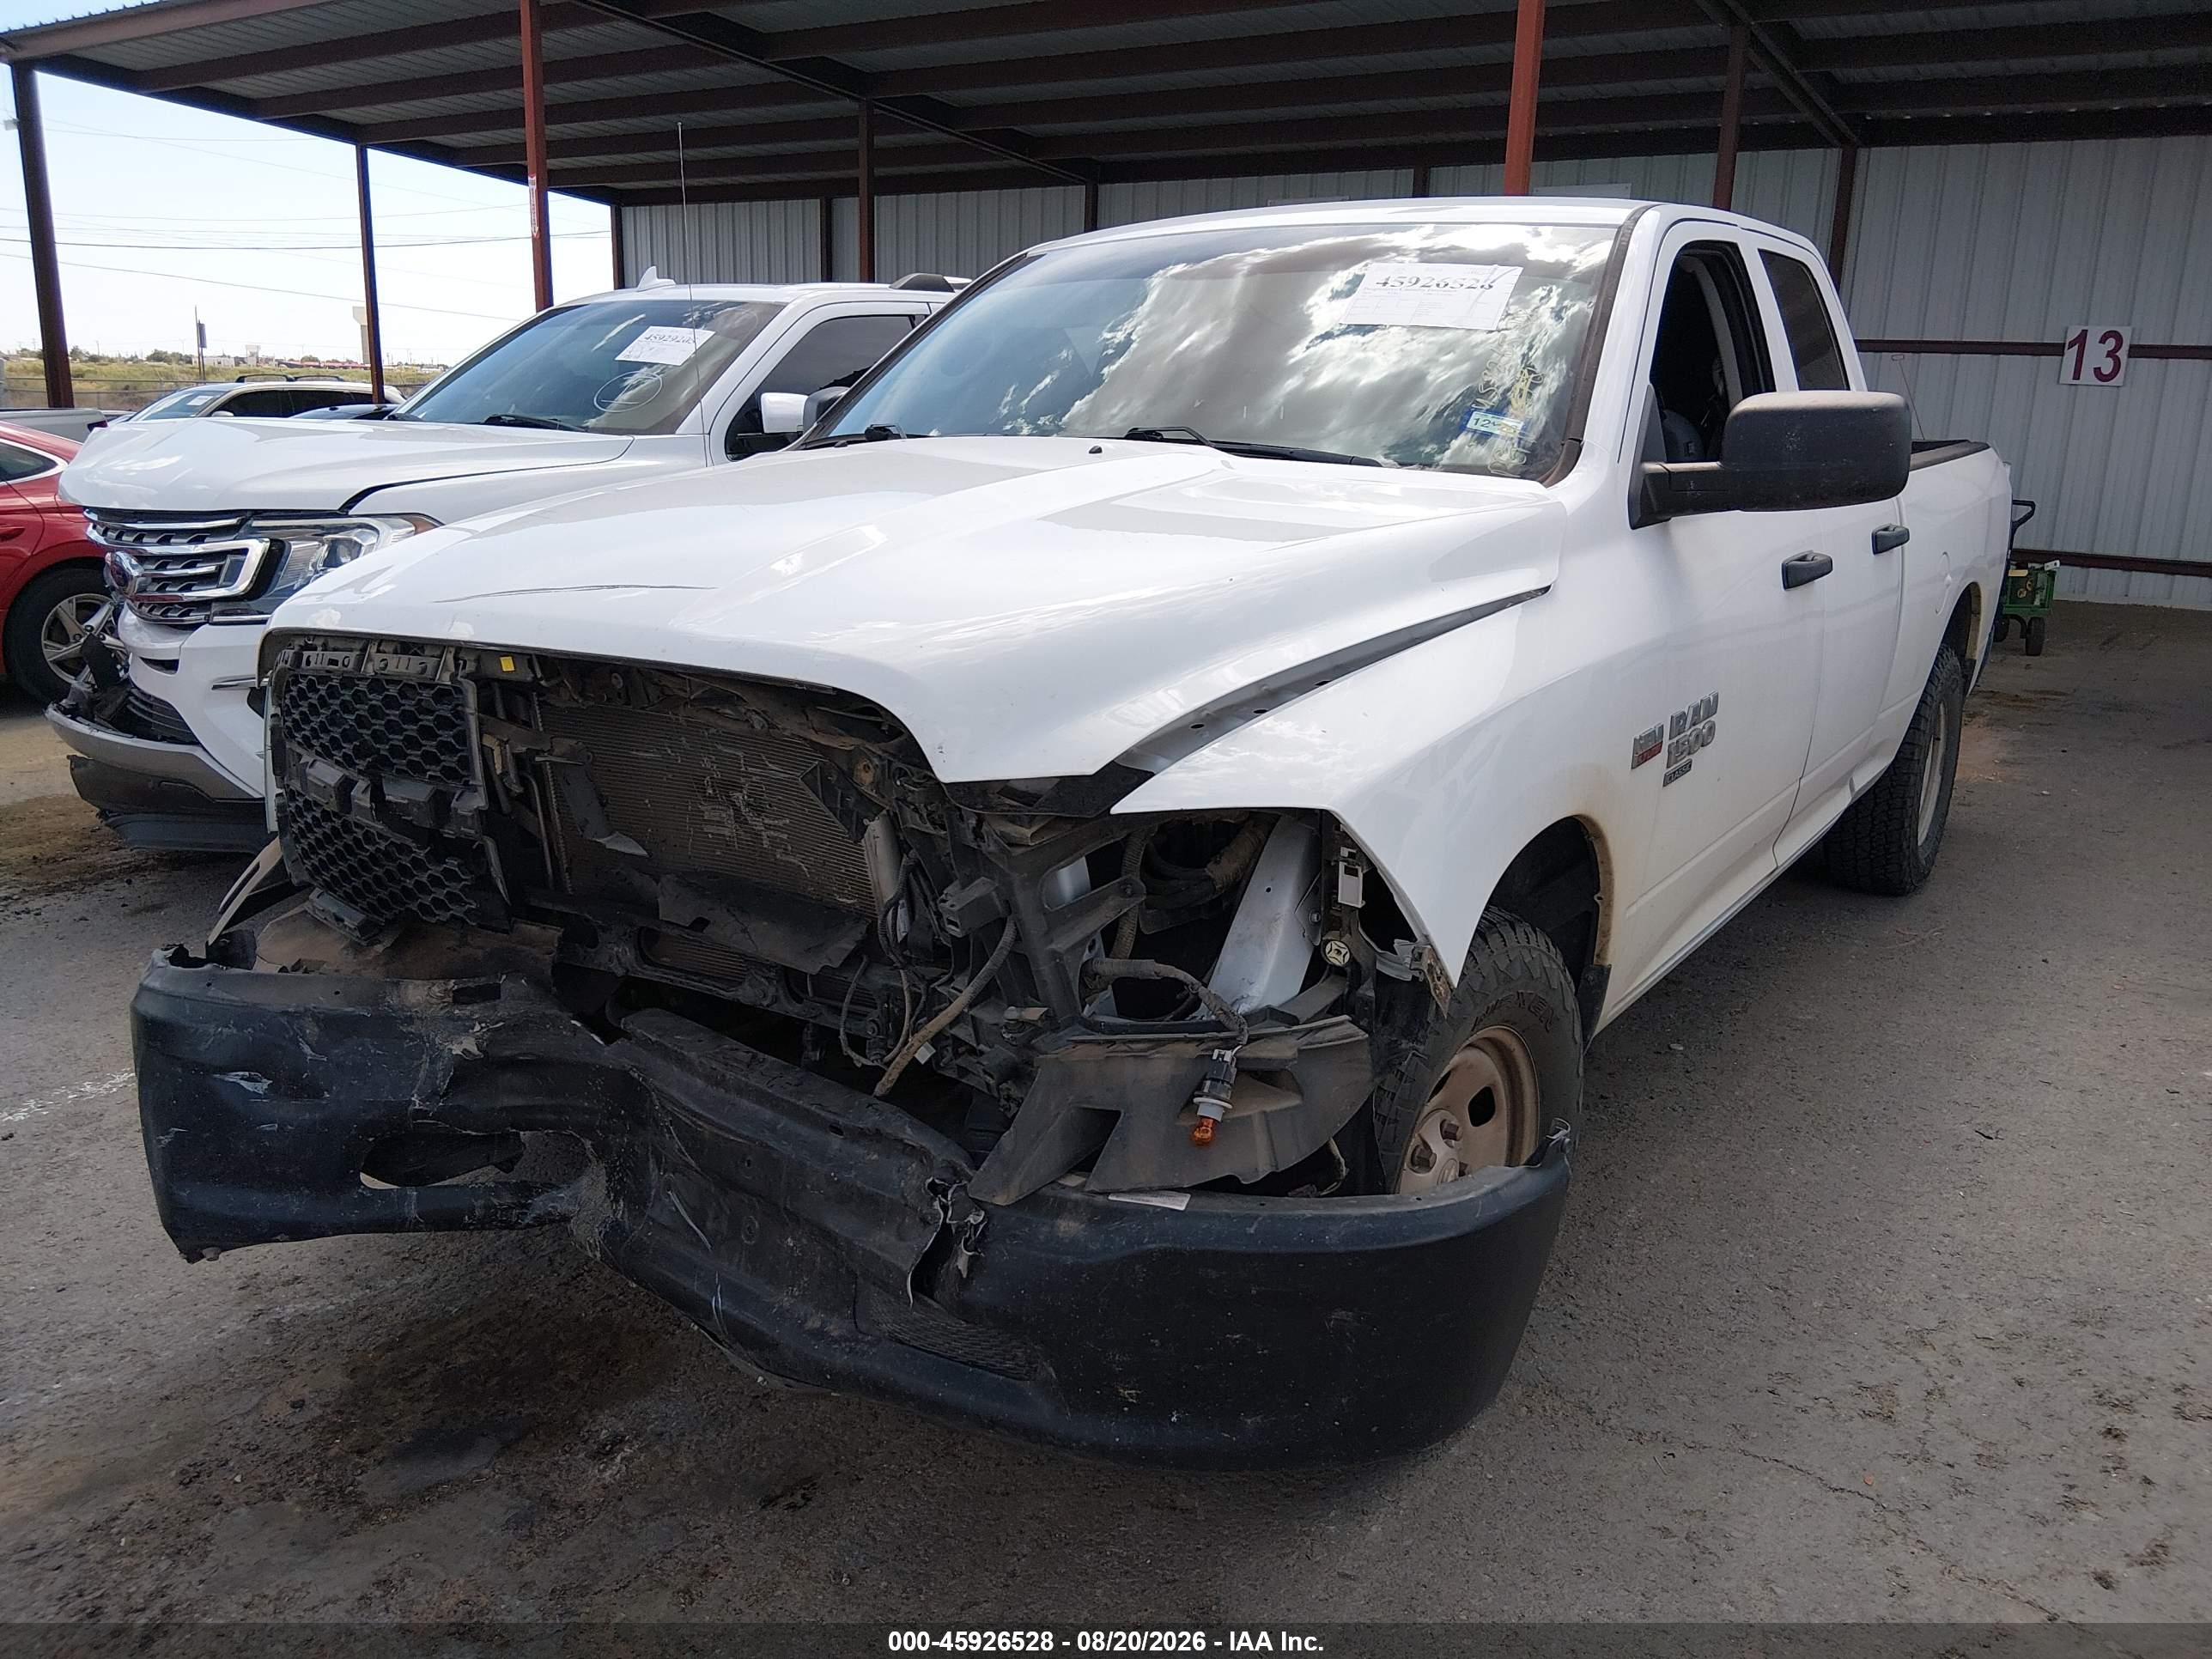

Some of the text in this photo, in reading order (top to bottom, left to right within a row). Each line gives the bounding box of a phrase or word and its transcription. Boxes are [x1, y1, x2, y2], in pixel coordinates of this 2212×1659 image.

[1376, 275, 1495, 290] 45926528
[2067, 329, 2124, 383] 13
[1668, 690, 1719, 740] RAM
[1666, 720, 1717, 769] 1500
